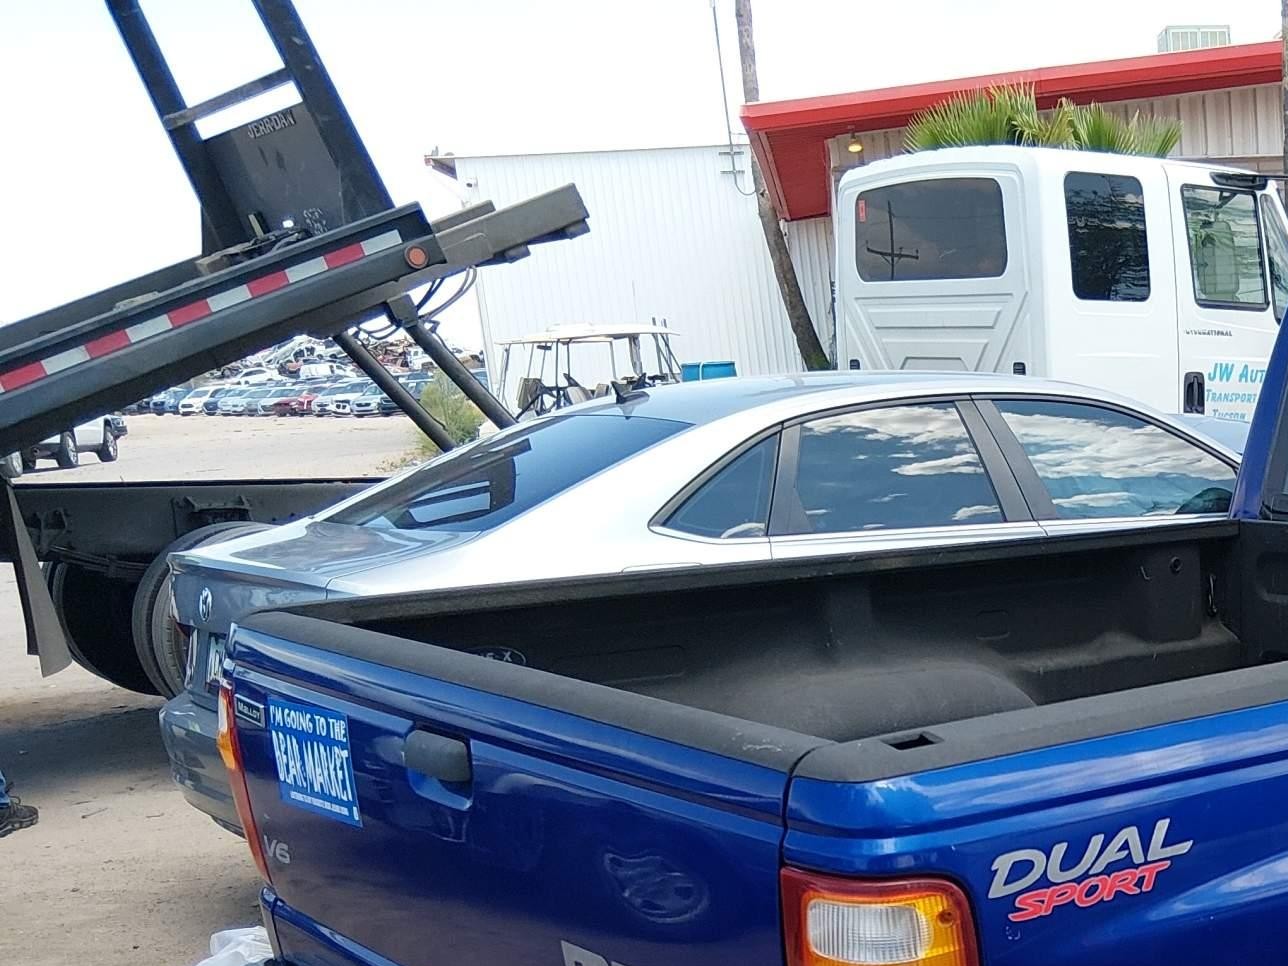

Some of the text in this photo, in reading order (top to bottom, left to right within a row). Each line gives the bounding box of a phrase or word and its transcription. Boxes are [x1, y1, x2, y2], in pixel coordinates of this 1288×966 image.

[1208, 362, 1266, 383] JW AUT
[269, 705, 347, 742] I'M GOING TO THE
[302, 740, 353, 802] MARKET
[263, 834, 290, 864] V6
[988, 817, 1194, 899] DUAL
[1008, 860, 1171, 922] SPORT
